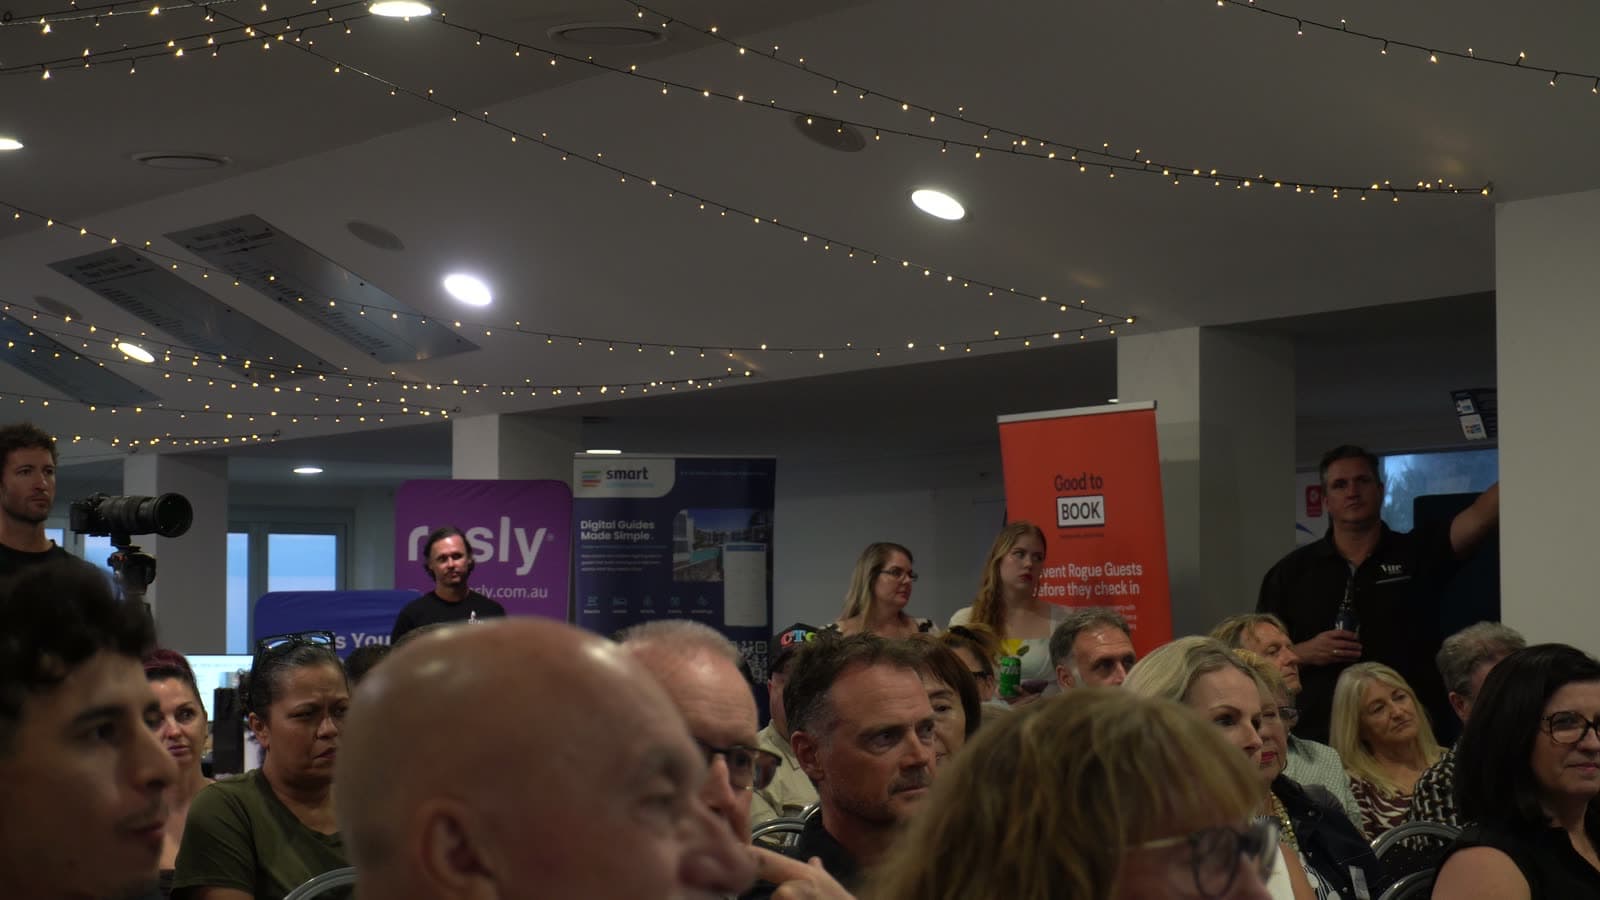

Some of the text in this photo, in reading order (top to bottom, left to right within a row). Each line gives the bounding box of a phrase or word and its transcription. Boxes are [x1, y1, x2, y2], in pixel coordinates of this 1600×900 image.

[606, 467, 648, 480] smart
[1054, 472, 1103, 491] Good to
[1061, 501, 1101, 520] BOOK
[580, 520, 655, 531] Digital Guides
[581, 531, 612, 540] Made
[408, 516, 547, 576] rsly
[1068, 563, 1104, 582] Rogue
[1104, 561, 1143, 577] Guests
[1068, 583, 1092, 599] they
[1095, 581, 1127, 596] check
[1129, 581, 1140, 595] in
